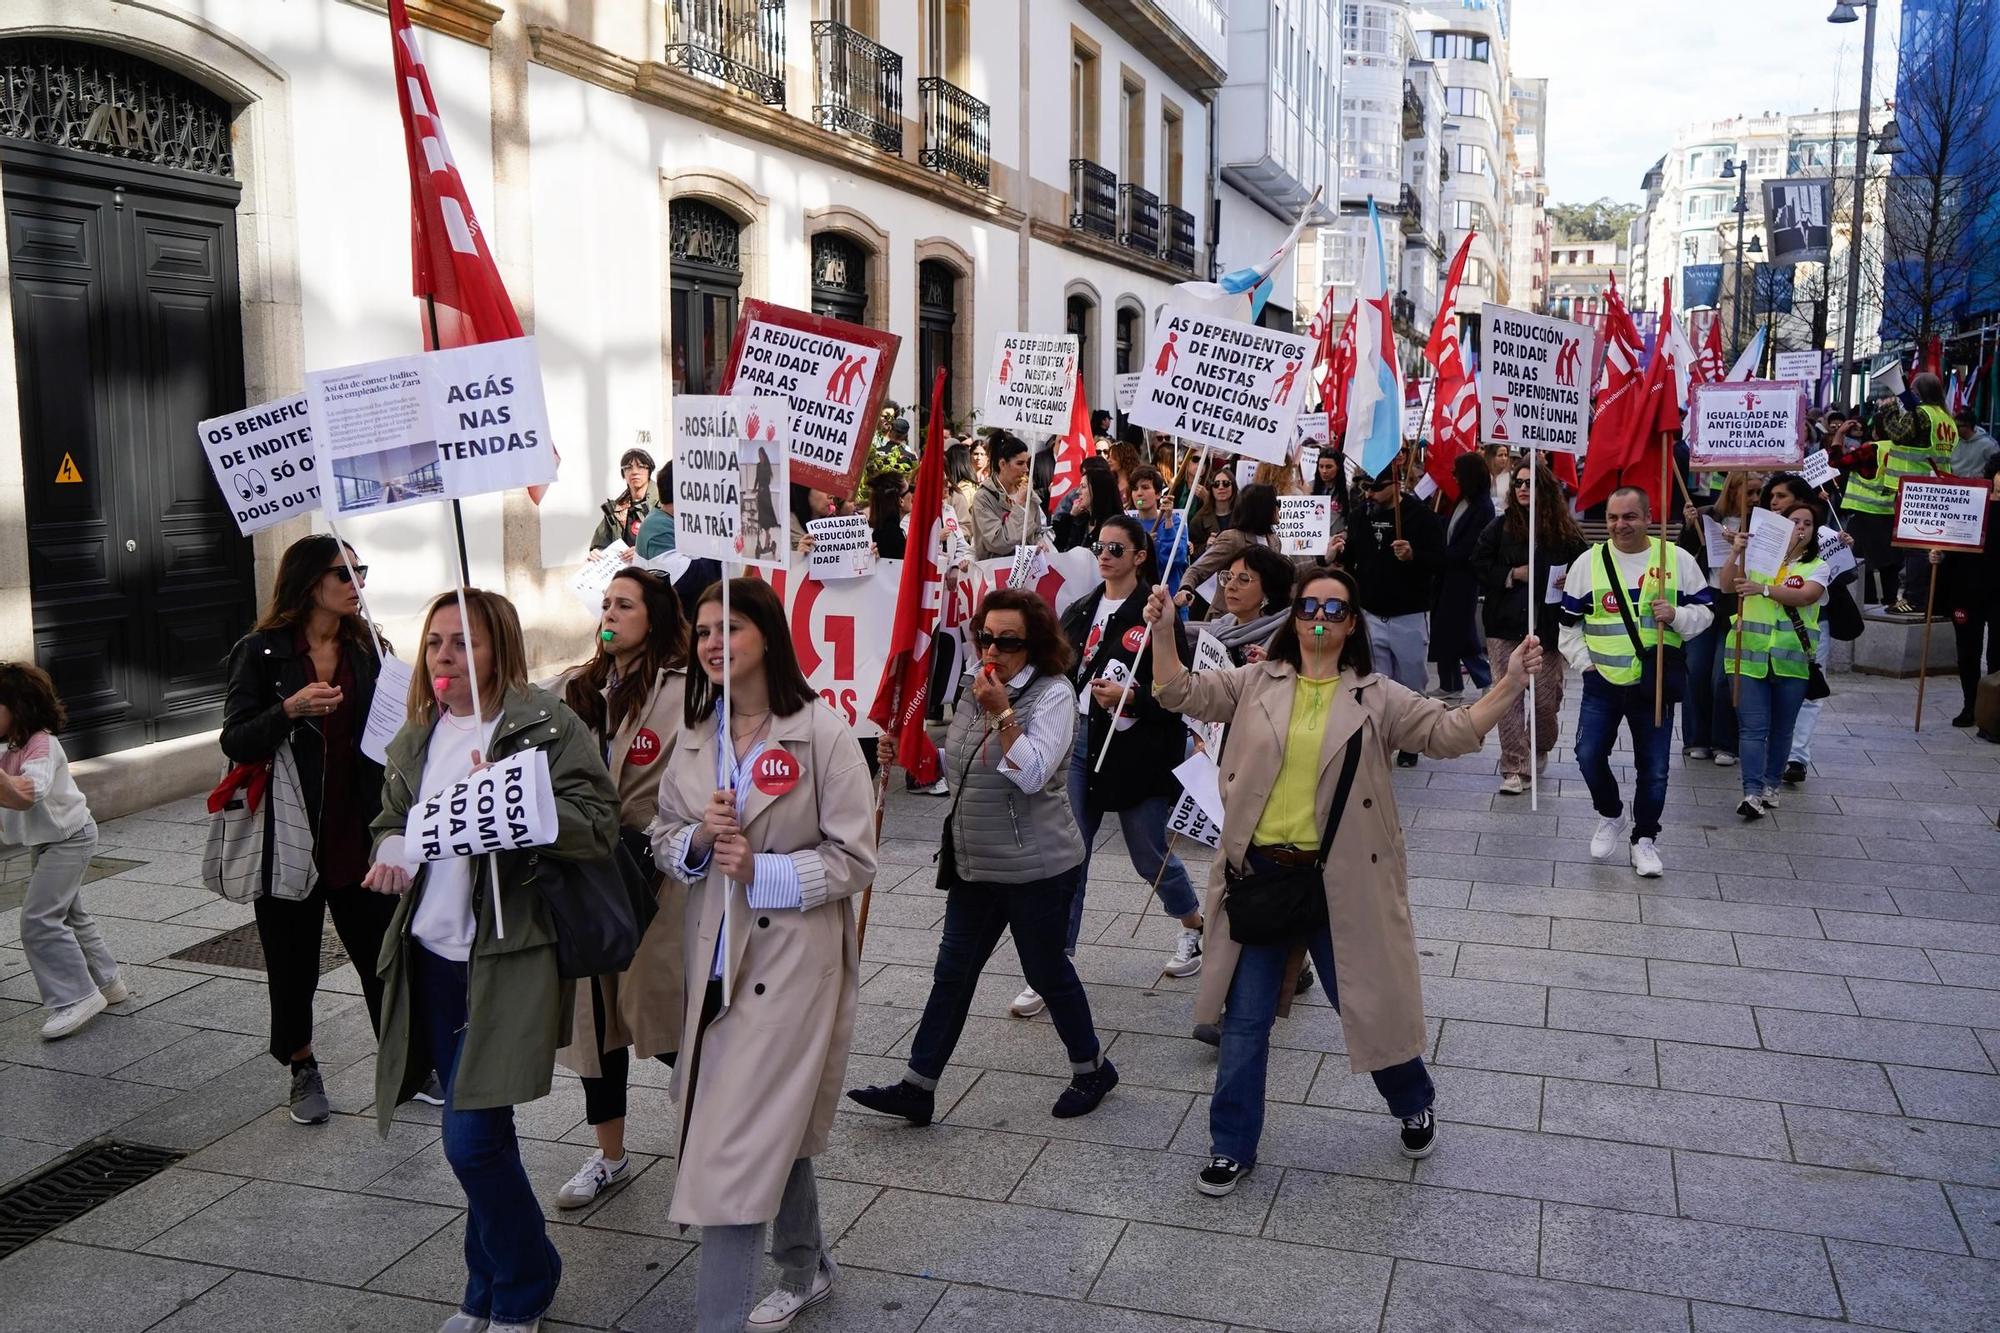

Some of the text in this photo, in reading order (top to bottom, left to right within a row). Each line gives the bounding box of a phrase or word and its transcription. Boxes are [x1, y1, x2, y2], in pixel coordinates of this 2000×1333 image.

[1169, 317, 1306, 361] AS DEPENDENT@S
[1493, 319, 1563, 345] A REDUCCIÓN
[750, 326, 846, 361] A REDUCCIÓN
[1004, 338, 1018, 349] AS
[1493, 340, 1547, 363] POR IDADE
[745, 345, 820, 377] POR IDADE
[1019, 354, 1064, 368] DE INDITEX
[1188, 340, 1275, 373] DE INDITEX
[350, 380, 360, 389] de
[361, 376, 388, 387] comer
[390, 370, 418, 381] Inditex
[740, 365, 799, 392] PARA AS
[1025, 369, 1057, 381] NESTAS
[1196, 362, 1256, 389] NESTAS
[1493, 361, 1538, 381] PARA AS
[331, 392, 343, 401] los
[345, 385, 389, 399] empleados
[401, 379, 420, 388] Zara
[448, 374, 514, 404] AGÁS
[1010, 382, 1063, 397] CONDICIÓNS
[1171, 375, 1271, 412] CONDICIÓNS
[1508, 381, 1579, 405] DEPENDENTAS
[999, 395, 1067, 412] NON CHEGAMOS
[1152, 389, 1189, 410] NON
[1192, 400, 1278, 434] CHEGAMOS
[1513, 403, 1578, 425] NON É UNHA
[459, 406, 511, 430] NAS
[685, 411, 739, 438] ROSALÍA
[1016, 409, 1053, 426] Á VELLEZ
[1706, 410, 1789, 420] IGUALDADE NA
[208, 426, 233, 445] OS
[792, 416, 847, 446] É UNHA
[1175, 412, 1245, 445] Á VELLEZ
[1522, 425, 1577, 444] REALIDADE
[1729, 430, 1765, 439] PRIMA
[438, 430, 538, 460] TENDAS
[791, 438, 844, 467] LIDADE
[1708, 438, 1785, 448] VINCULACIÓN
[220, 450, 245, 469] DE
[271, 454, 316, 482] SÓ O
[687, 449, 740, 471] COMIDA
[680, 478, 738, 505] CADA DÍA
[1905, 494, 1938, 502] INDITEX
[1906, 485, 1923, 493] NAS
[1926, 487, 1958, 496] TENDAS
[237, 485, 321, 523] DOUS OU T
[1282, 500, 1315, 508] SOMOS
[1904, 501, 1950, 511] QUEREMOS
[680, 511, 733, 538] TRA TRÁ!
[810, 518, 859, 530] IGUALDADE
[1902, 517, 1946, 527] QUE FACER
[1903, 509, 1932, 518] COMER
[1940, 512, 1960, 520] NON
[1962, 514, 1978, 522] TER
[814, 529, 865, 541] REDUCIÓN DE
[814, 541, 869, 553] XORNADA POR
[813, 555, 840, 565] IDADE
[632, 736, 653, 750] IG
[761, 759, 789, 776] CIG
[450, 783, 468, 836] ADA
[477, 779, 506, 852] COMI
[1189, 811, 1208, 838] REC
